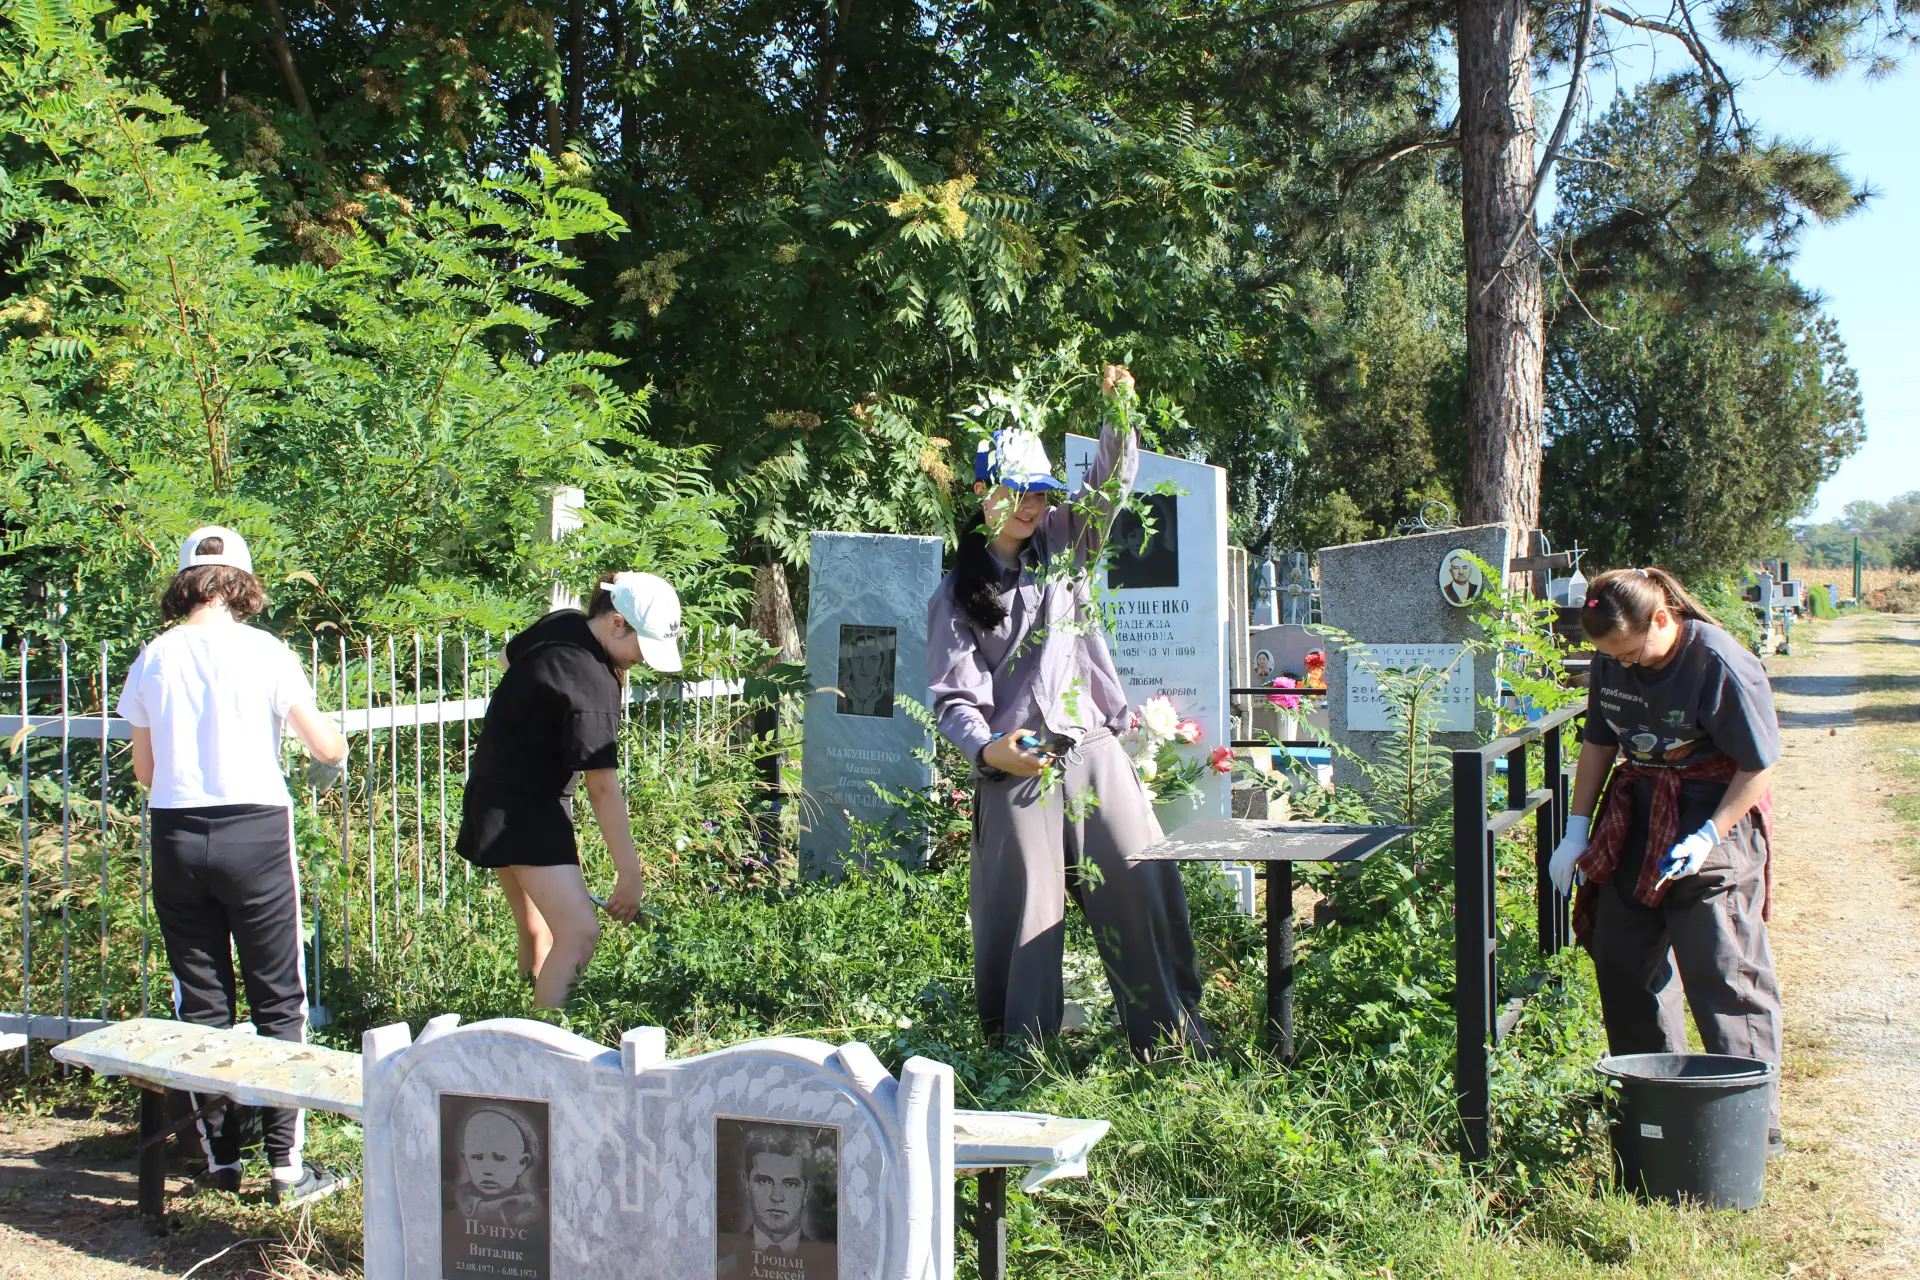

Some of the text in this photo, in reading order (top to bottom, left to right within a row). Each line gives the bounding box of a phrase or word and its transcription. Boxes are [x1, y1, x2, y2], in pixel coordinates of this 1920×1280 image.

[1175, 647, 1196, 656] 1999
[469, 1242, 524, 1261] Виталик
[456, 1261, 494, 1274] 23.08.1971
[501, 1267, 537, 1279] 6.08.1973
